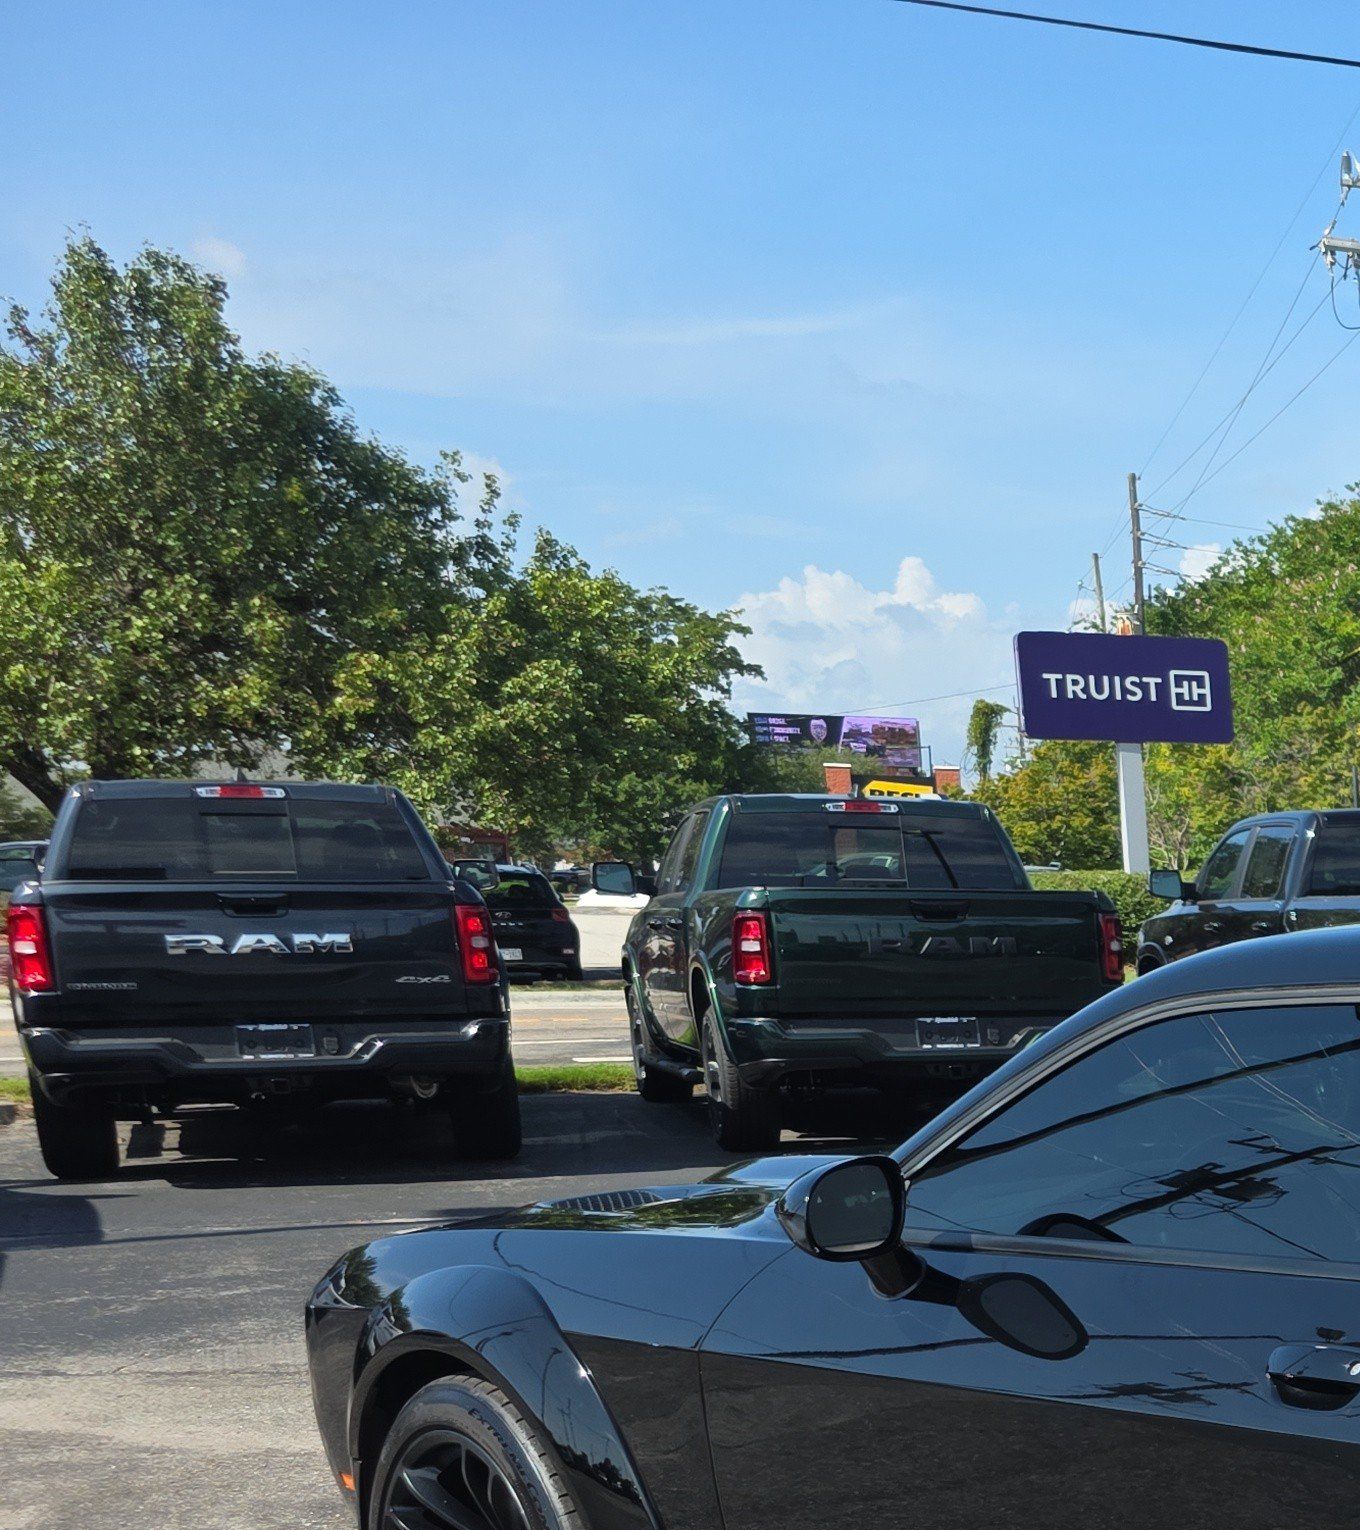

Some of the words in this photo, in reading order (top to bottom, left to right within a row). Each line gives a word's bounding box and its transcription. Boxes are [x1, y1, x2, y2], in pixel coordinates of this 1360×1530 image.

[1042, 673, 1163, 702] TRUIST
[164, 933, 354, 955] RAM
[867, 936, 1018, 955] RAM
